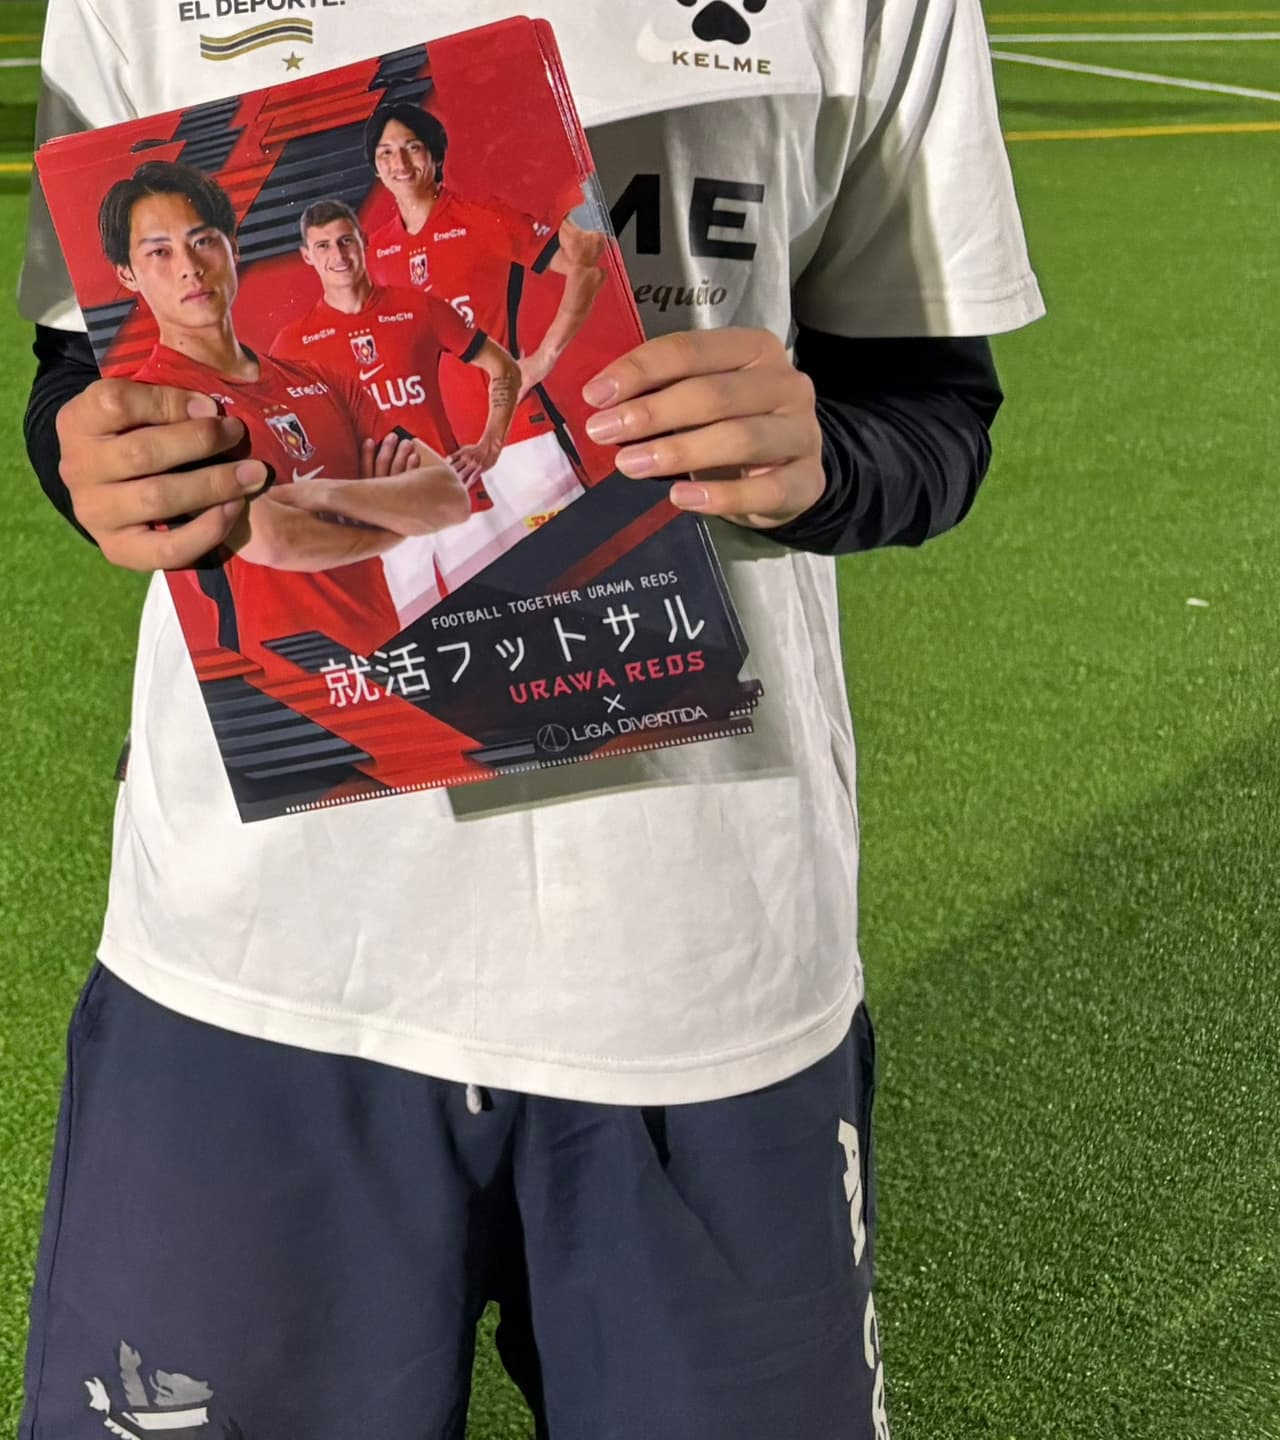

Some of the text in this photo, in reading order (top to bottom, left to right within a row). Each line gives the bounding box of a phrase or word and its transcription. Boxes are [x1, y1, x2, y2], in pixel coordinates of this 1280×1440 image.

[179, 1, 211, 22] EL
[672, 50, 771, 75] KELME
[366, 375, 426, 411] LUS
[431, 570, 678, 631] FOOTBALL TOGETHER URAWA REDS
[319, 594, 705, 708] 就活フットサル
[509, 650, 706, 705] URAWA REDS
